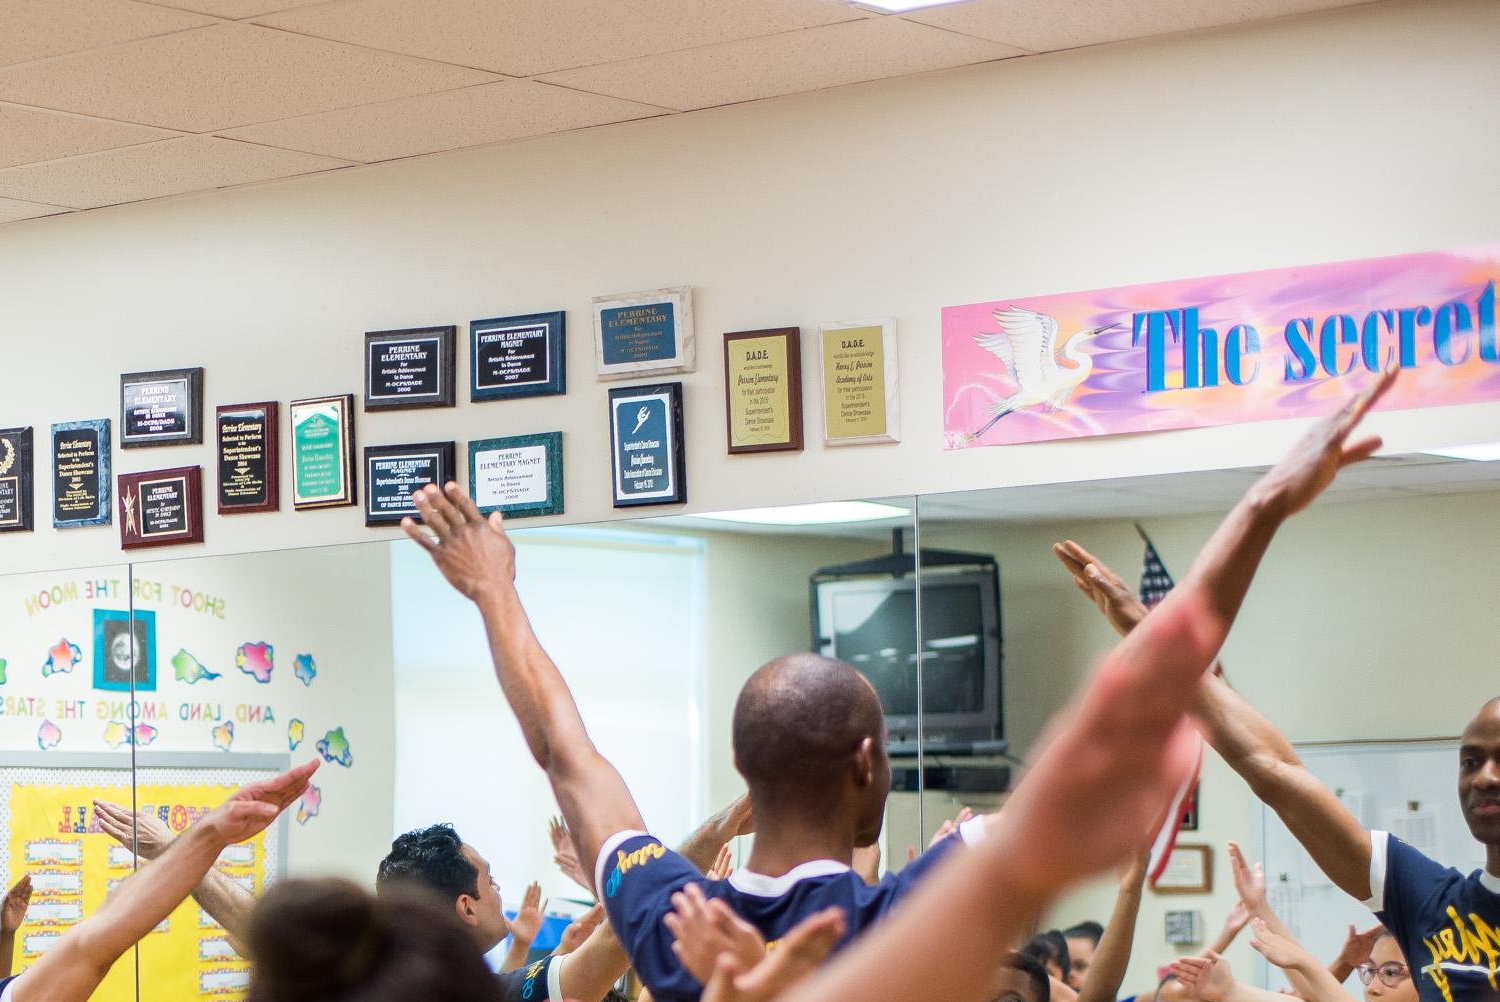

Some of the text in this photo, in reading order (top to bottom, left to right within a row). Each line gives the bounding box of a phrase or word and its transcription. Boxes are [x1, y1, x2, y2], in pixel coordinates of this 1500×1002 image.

[618, 308, 657, 319] PERRINE
[609, 314, 667, 327] ELEMENTARY
[481, 330, 543, 343] PERRINE ELEMENTARY
[1132, 279, 1500, 394] The secret
[501, 340, 523, 348] MAGNET
[842, 340, 864, 349] D.A.D.E.
[389, 345, 420, 354] PERRINE
[381, 352, 427, 361] ELEMENTARY
[746, 350, 768, 360] D.A.D.E.
[836, 362, 849, 372] Henry
[856, 361, 872, 370] Perrine
[738, 373, 778, 386] Perrine Elementary
[836, 376, 856, 384] Academy
[863, 373, 872, 382] Arts
[142, 386, 169, 395] PERRINE
[134, 394, 176, 404] ELEMENTARY
[222, 422, 262, 433] Perrine Elementary
[73, 440, 91, 450] Elementary
[223, 446, 261, 455] Superintendent's
[59, 462, 94, 471] Superintendent's
[376, 460, 431, 470] PERRINE ELEMENTARY
[481, 458, 540, 470] ELEMENTARY MAGNET
[147, 492, 178, 501] ELEMENTARY
